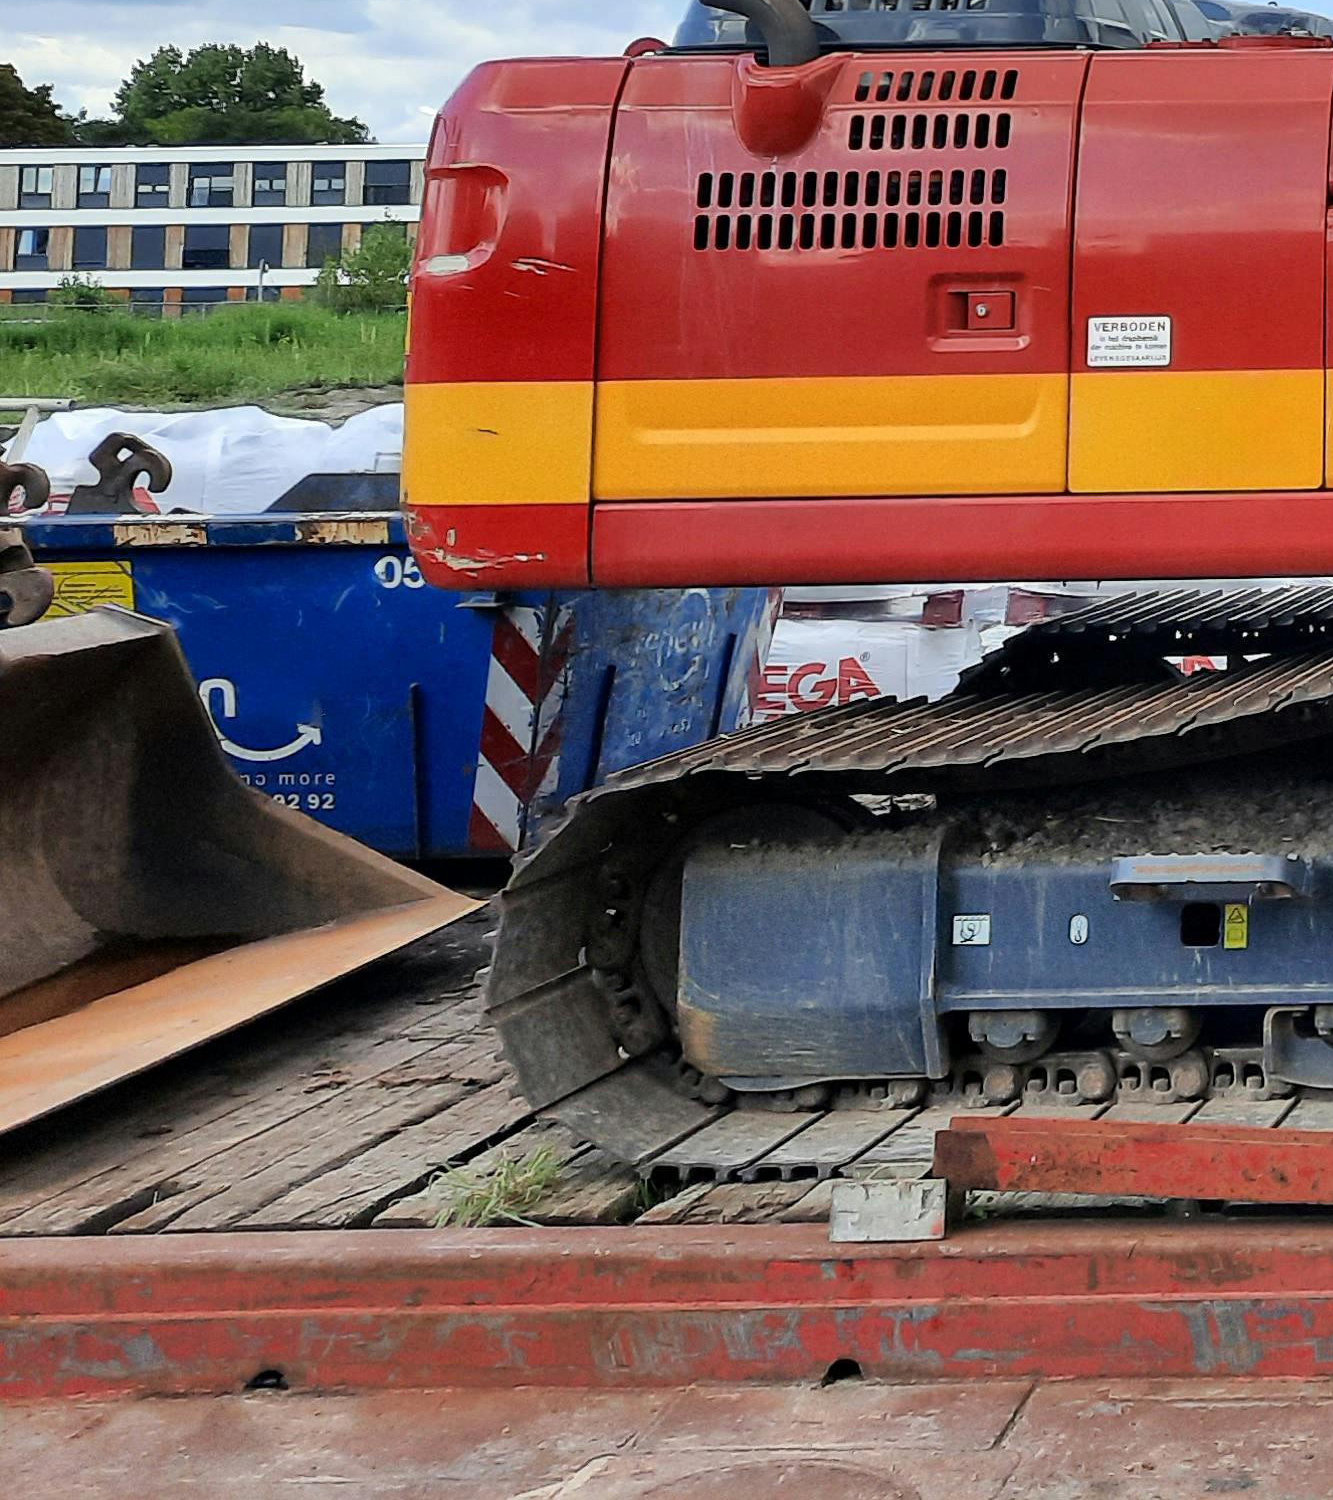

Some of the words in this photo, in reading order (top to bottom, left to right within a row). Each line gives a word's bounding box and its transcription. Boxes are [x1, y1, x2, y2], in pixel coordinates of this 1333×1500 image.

[1094, 322, 1166, 332] VERBODEN
[279, 773, 336, 786] more
[307, 793, 336, 809] 92
